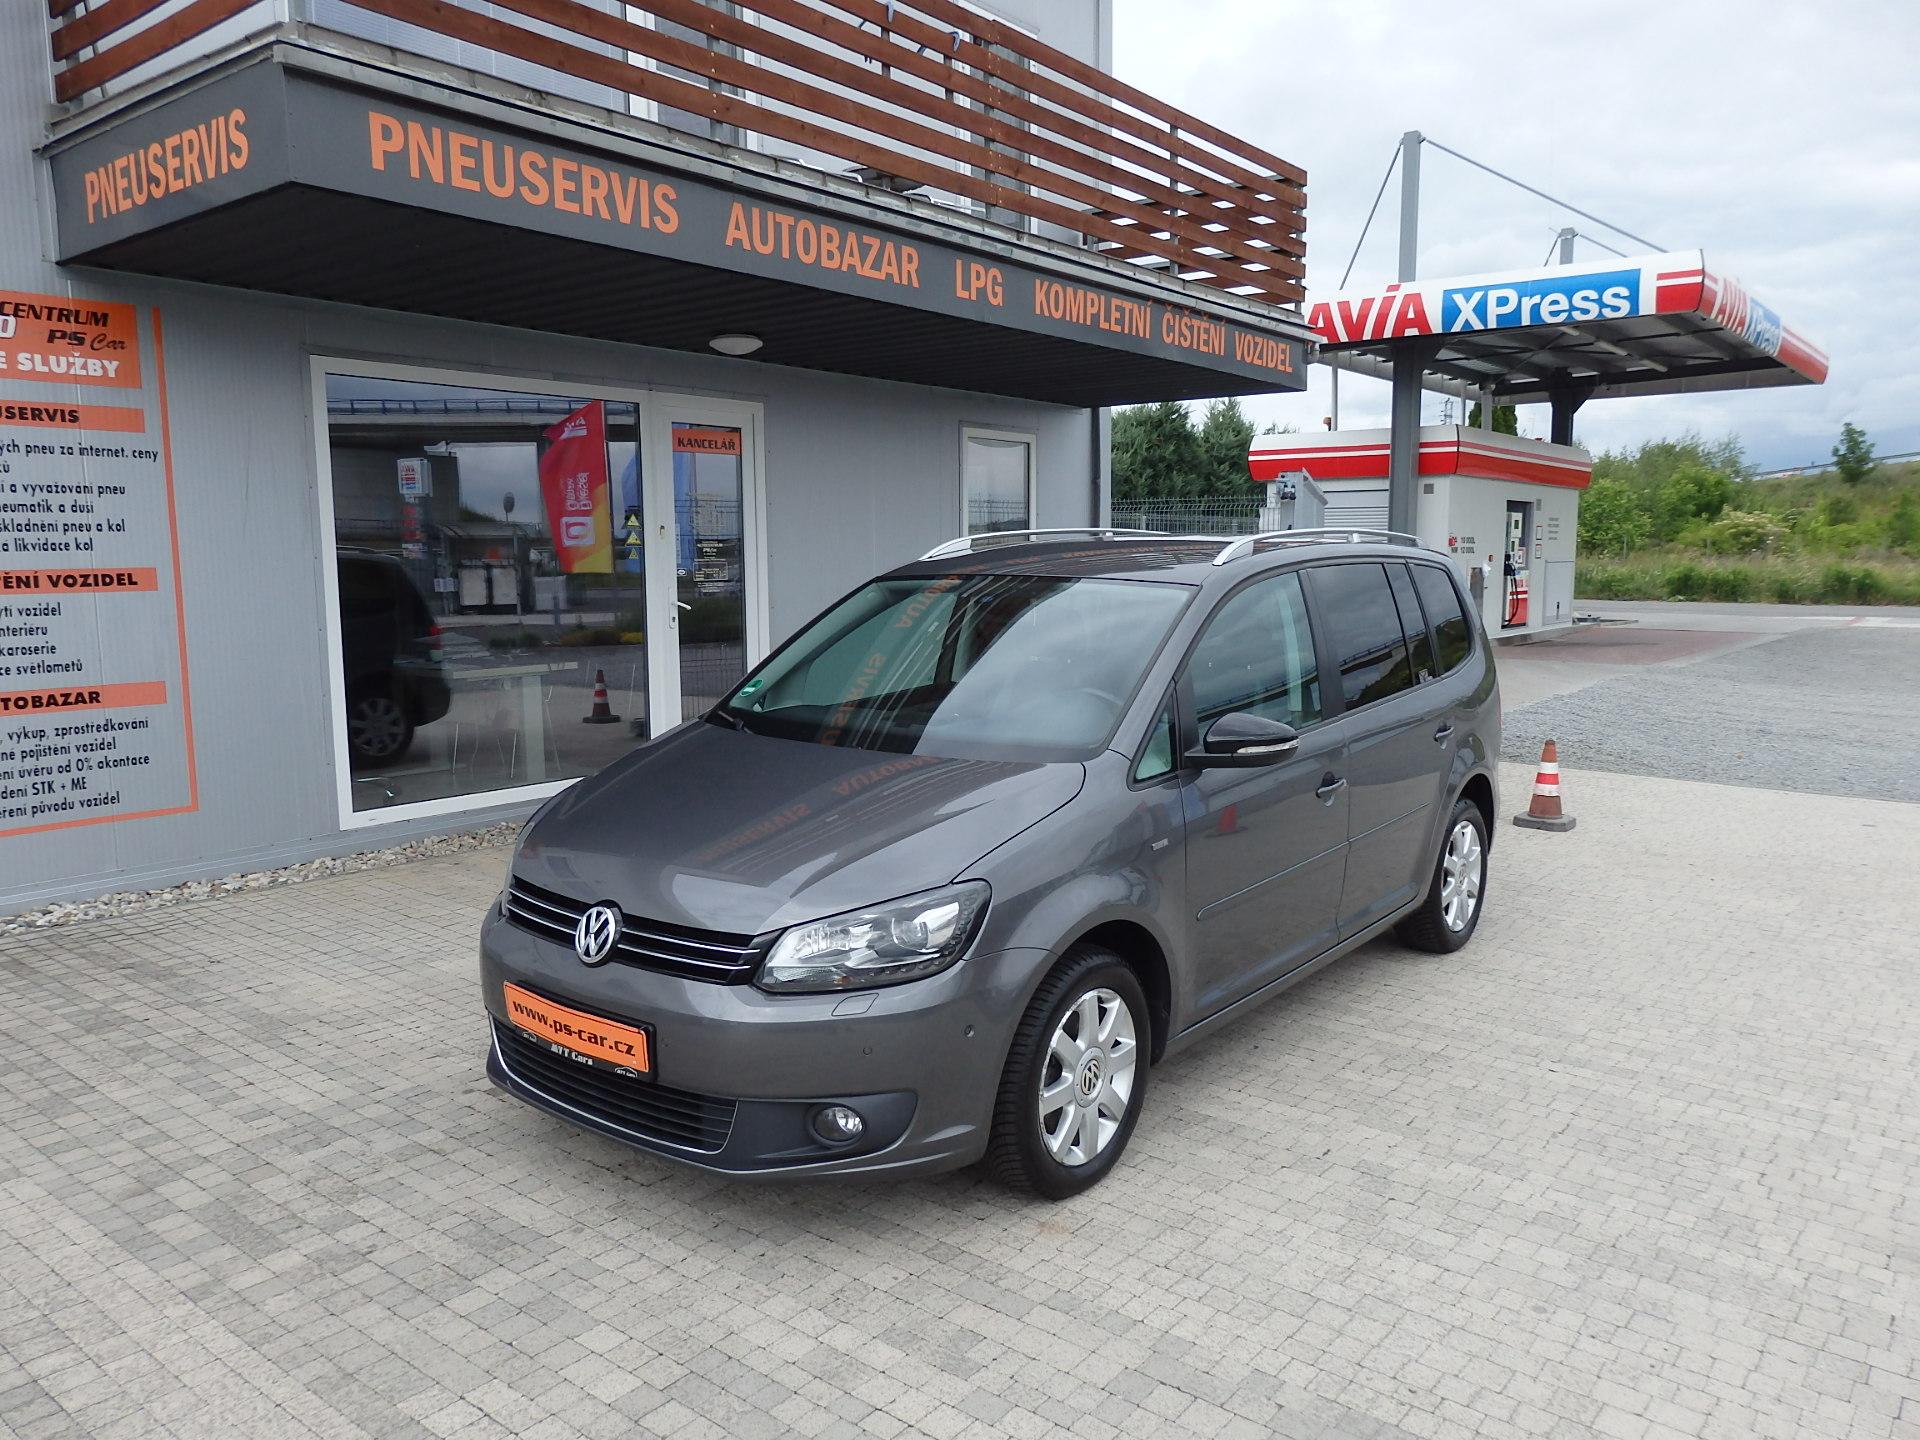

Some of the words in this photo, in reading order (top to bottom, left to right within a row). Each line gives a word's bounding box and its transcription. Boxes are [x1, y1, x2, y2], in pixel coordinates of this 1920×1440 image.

[84, 108, 249, 225] PNEUSERVIS
[367, 111, 681, 234] PNEUSERVIS
[725, 202, 920, 288] AUTOBAZAR
[955, 259, 1003, 307] LPG
[1035, 279, 1151, 339] KOMPLETNÍ
[1162, 303, 1226, 356] ČIŠTĚNÍ
[1234, 330, 1293, 373] VOZIDEL
[0, 301, 109, 327] CENTRUM
[1450, 286, 1630, 333] XPress
[47, 329, 87, 346] PS
[90, 333, 127, 351] Car
[17, 351, 119, 378] SLUŽBY
[0, 406, 80, 423] SERVIS
[677, 437, 736, 450] KANCELÁŘ
[26, 444, 55, 457] pneu
[60, 445, 74, 455] za
[132, 449, 158, 462] ceny
[10, 484, 17, 493] a
[98, 485, 126, 498] pneu
[59, 503, 66, 513] a
[63, 523, 91, 535] pneu
[108, 518, 125, 532] kol
[14, 538, 70, 552] likvidace
[75, 537, 93, 551] kol
[0, 571, 40, 589] ĚNÍ
[47, 572, 138, 588] VOZIDEL
[17, 602, 61, 617] vozidel
[2, 691, 101, 711] TOBAZAR
[75, 736, 117, 754] vozidel
[58, 759, 71, 774] od
[76, 757, 93, 772] 0%
[97, 755, 150, 770] akontace
[32, 780, 56, 796] STK
[71, 776, 87, 791] ME
[79, 791, 120, 808] vozidel
[512, 1001, 636, 1057] www.ps-car.cz
[571, 1051, 593, 1065] Cars
